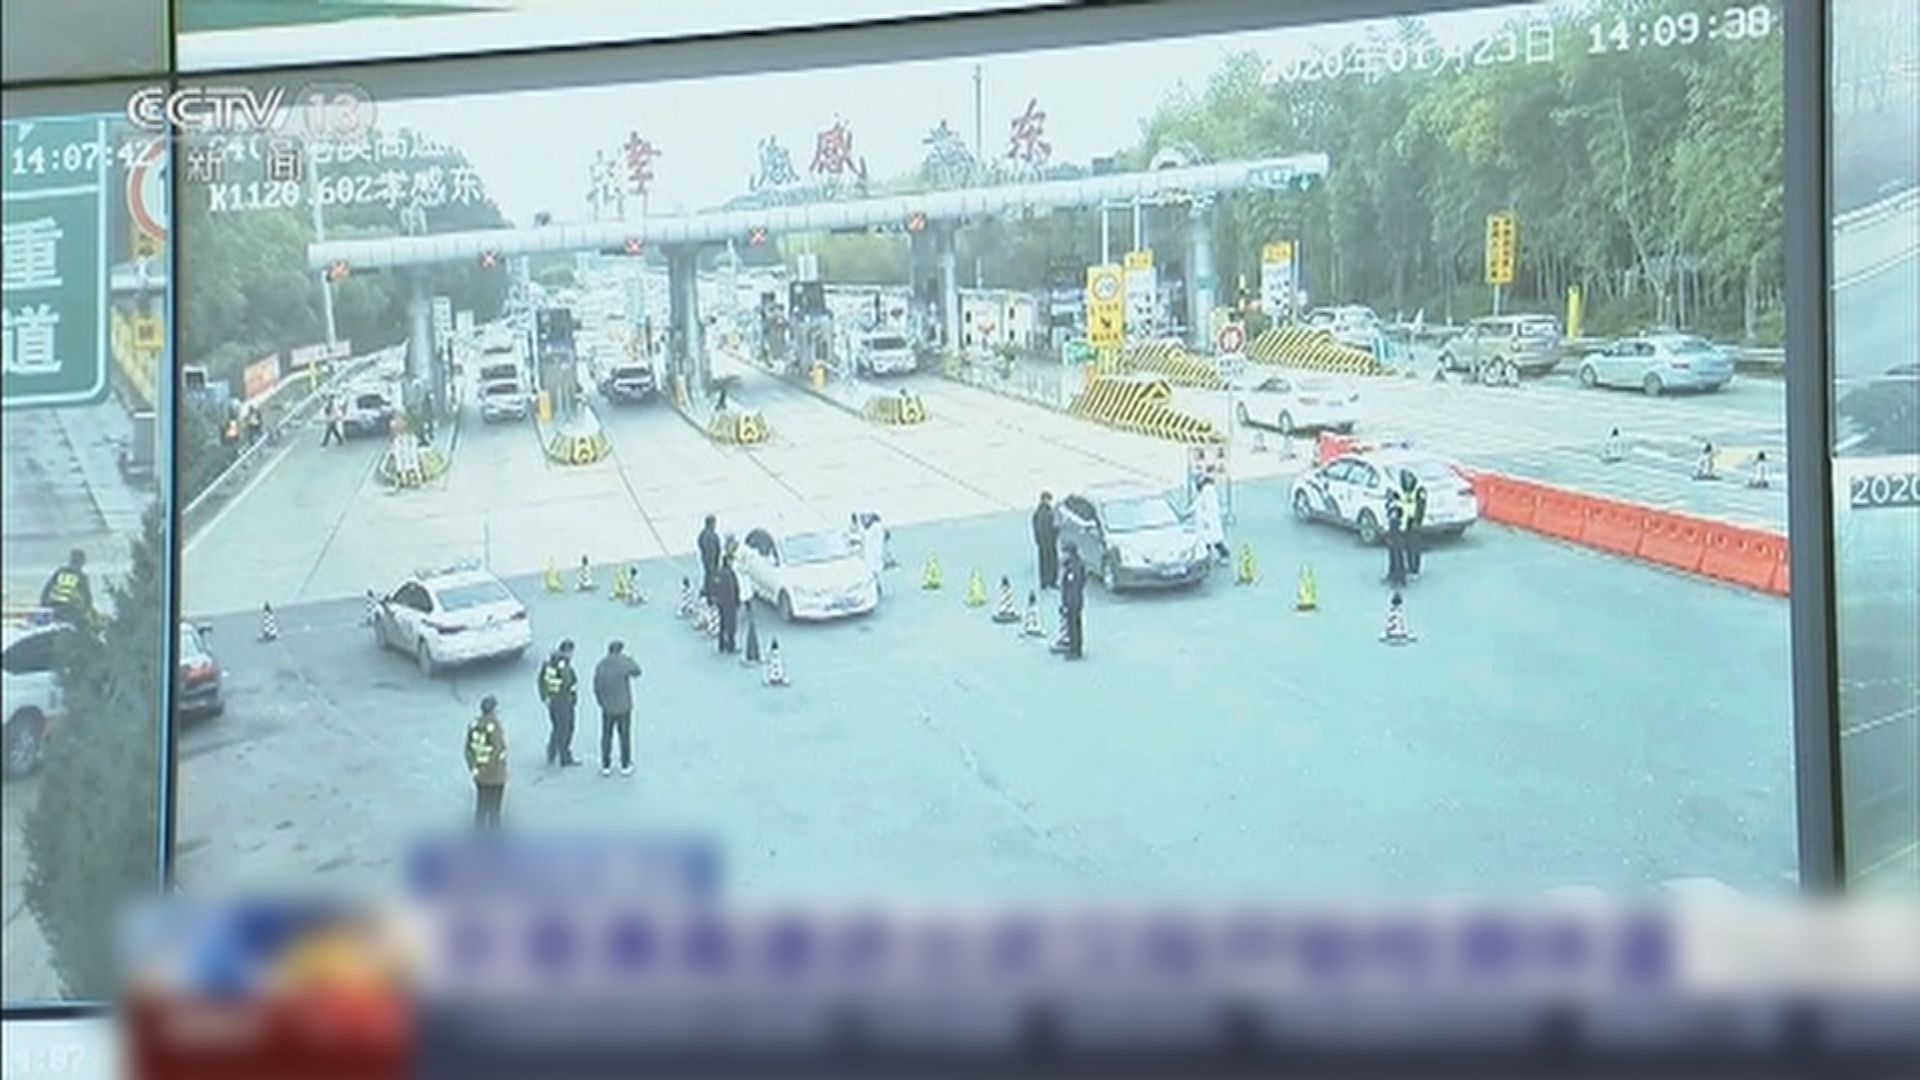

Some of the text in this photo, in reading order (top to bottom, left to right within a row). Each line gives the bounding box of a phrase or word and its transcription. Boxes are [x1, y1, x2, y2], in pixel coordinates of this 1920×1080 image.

[1260, 5, 1773, 84] 2020年01月23日 14:09:38
[11, 139, 154, 176] 14:07:42
